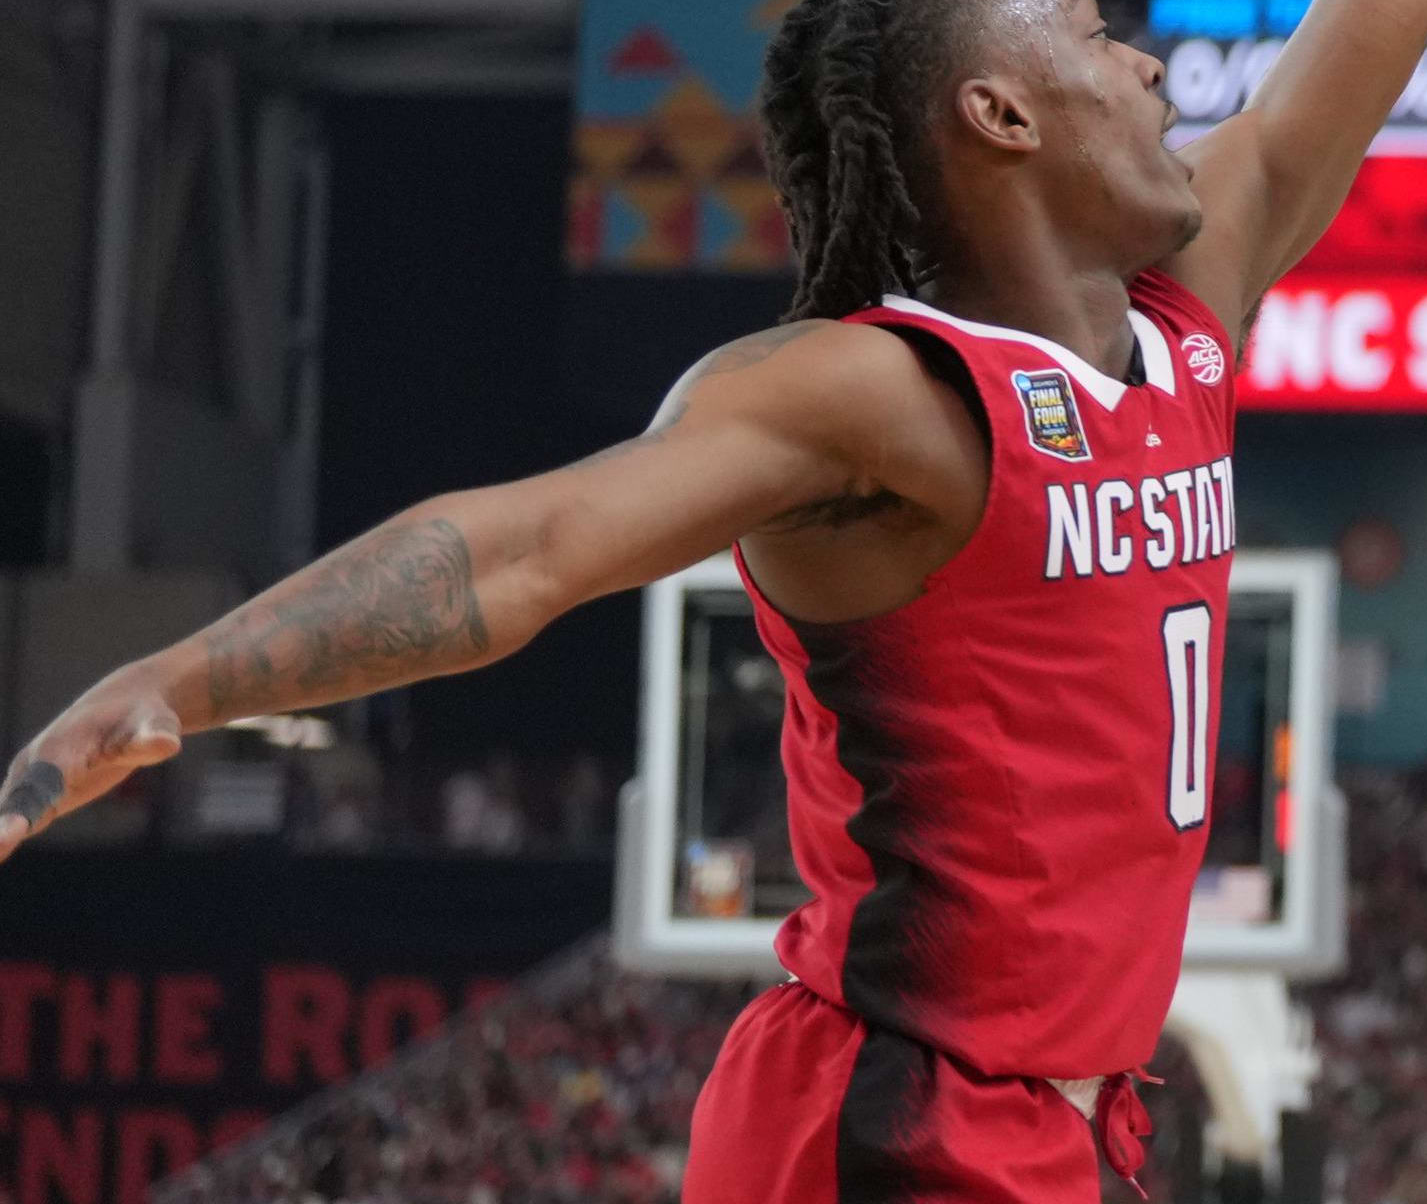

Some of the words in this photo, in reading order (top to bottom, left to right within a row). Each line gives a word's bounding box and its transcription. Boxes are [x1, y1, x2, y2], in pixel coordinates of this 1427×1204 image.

[1188, 347, 1219, 368] ACC
[1248, 290, 1395, 392] NC
[1028, 387, 1063, 407] FINAL
[1033, 405, 1068, 425] FOUR
[1045, 479, 1134, 579] NC
[1161, 600, 1212, 832] 0
[0, 961, 225, 1083] THE
[262, 962, 518, 1086] RO
